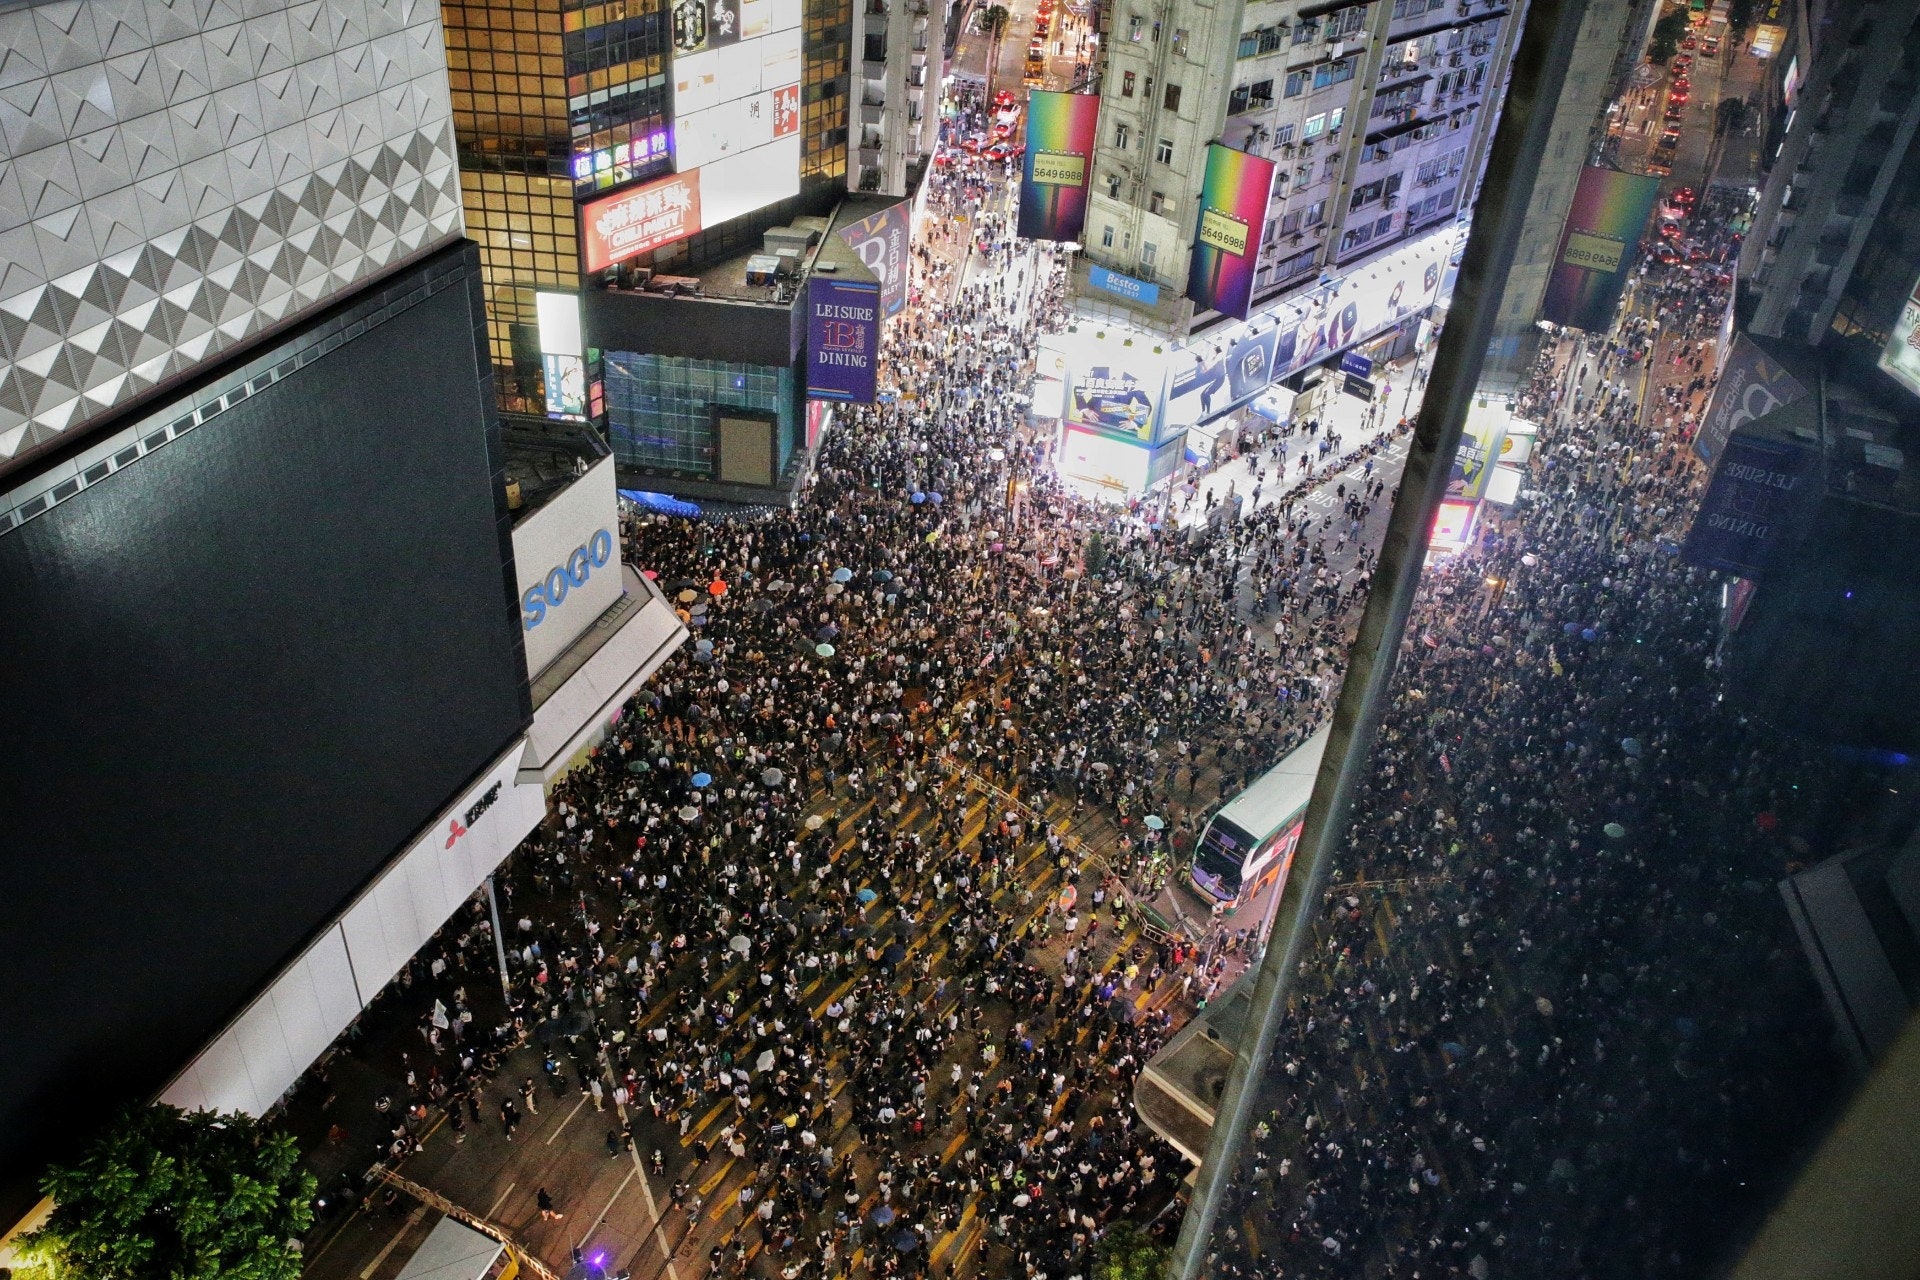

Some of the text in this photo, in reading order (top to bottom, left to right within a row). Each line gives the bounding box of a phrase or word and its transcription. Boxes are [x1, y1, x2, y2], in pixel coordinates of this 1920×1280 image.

[1034, 168, 1082, 181] 5649 6988
[643, 211, 680, 236] PARTY
[1202, 226, 1245, 250] 5649 6988
[887, 228, 902, 284] 金百利
[881, 283, 900, 299] ERLEY
[1106, 273, 1140, 291] Bestco
[816, 303, 873, 321] LEISURE
[819, 351, 867, 368] DINING
[1305, 490, 1338, 508] BUS
[521, 528, 612, 632] SOGO
